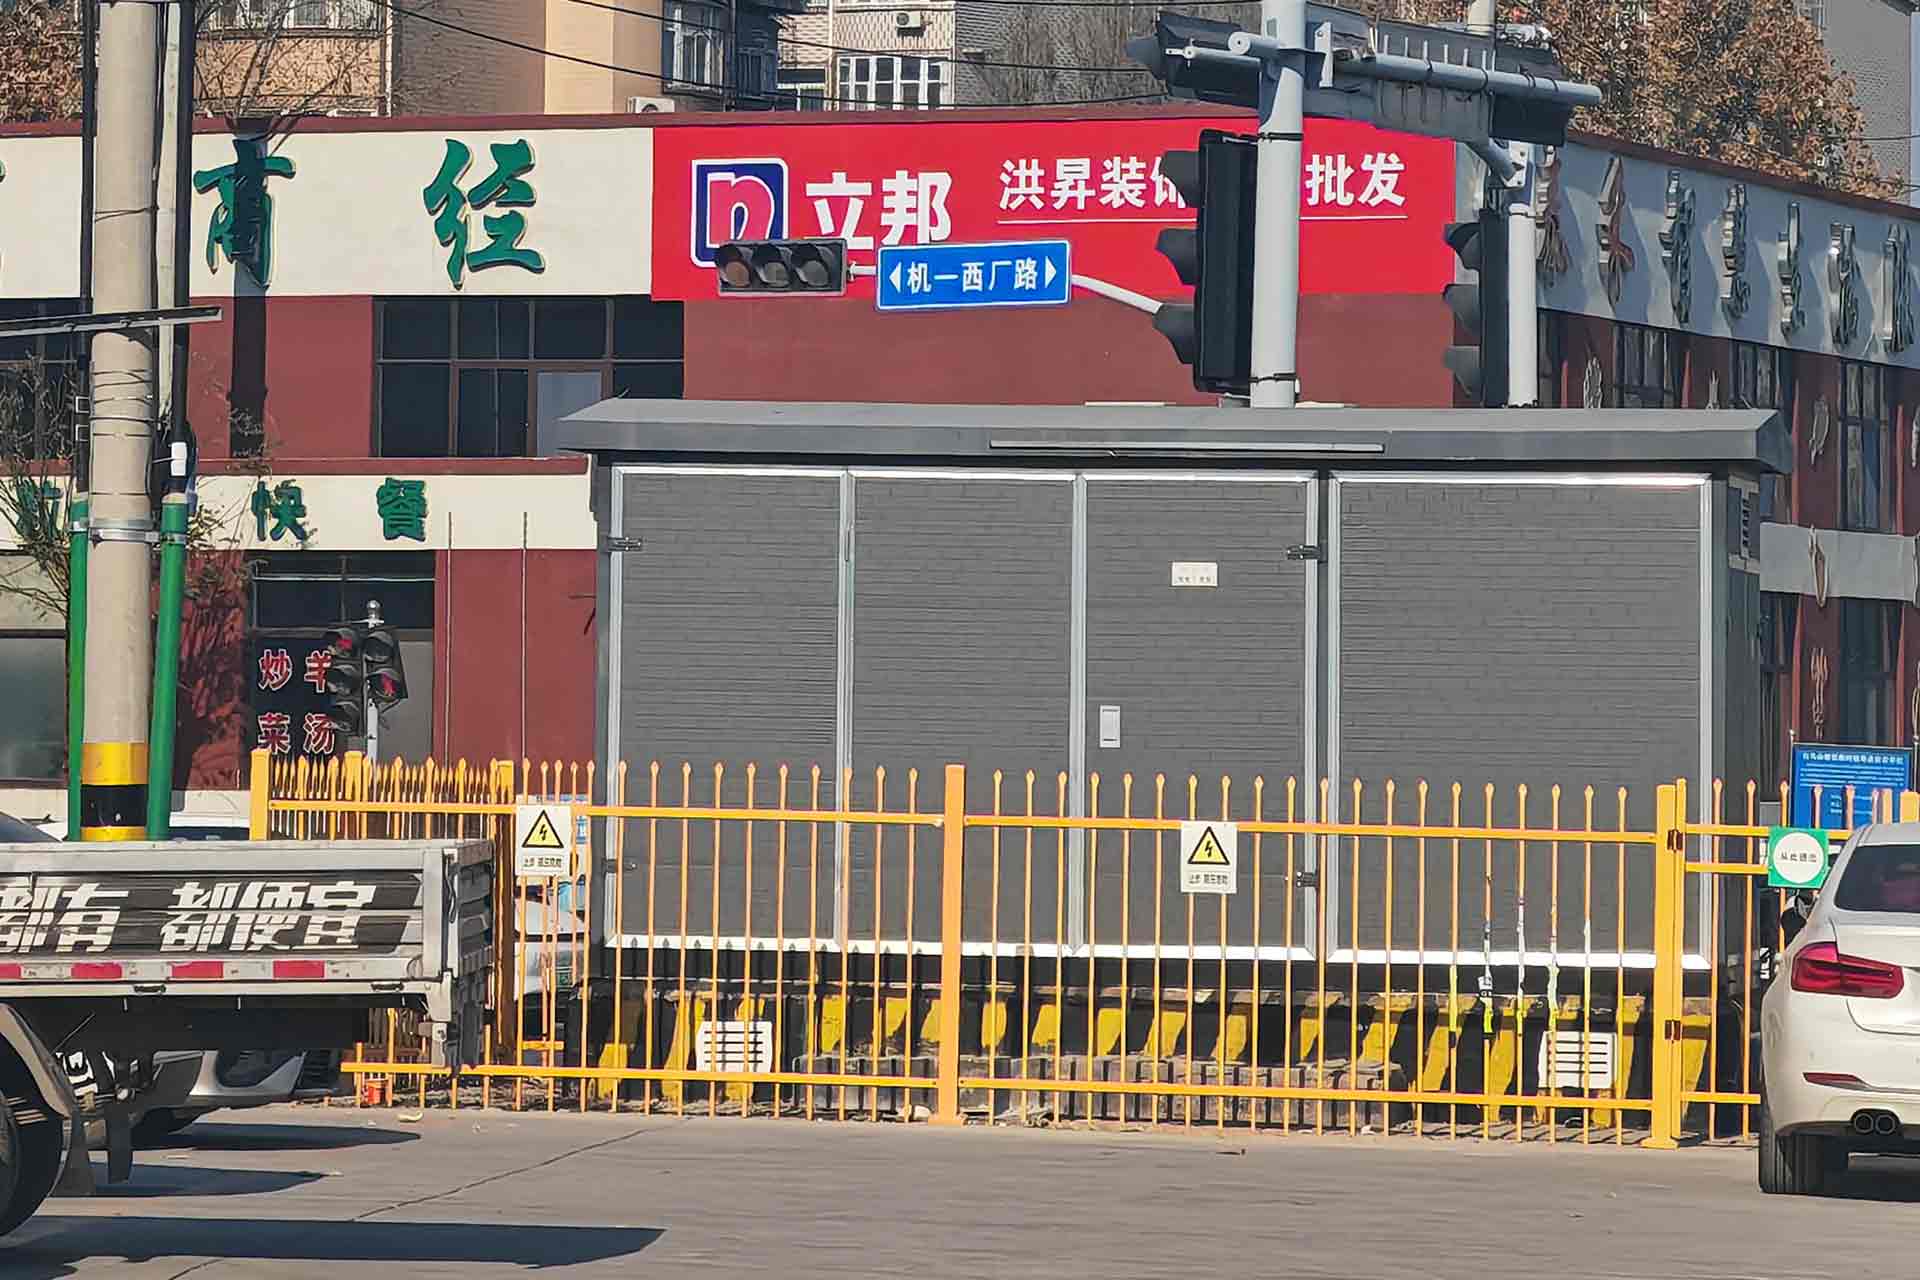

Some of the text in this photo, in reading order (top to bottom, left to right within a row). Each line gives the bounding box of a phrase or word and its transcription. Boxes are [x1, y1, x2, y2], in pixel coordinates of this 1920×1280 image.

[804, 170, 952, 251] 立邦
[1305, 152, 1405, 207] 批发
[907, 256, 1039, 295] 机一西厂路
[251, 477, 427, 542] 快餐
[258, 648, 293, 755] 炒菜
[302, 649, 337, 755] 羊汤
[0, 880, 377, 953] 都有 都便宜
